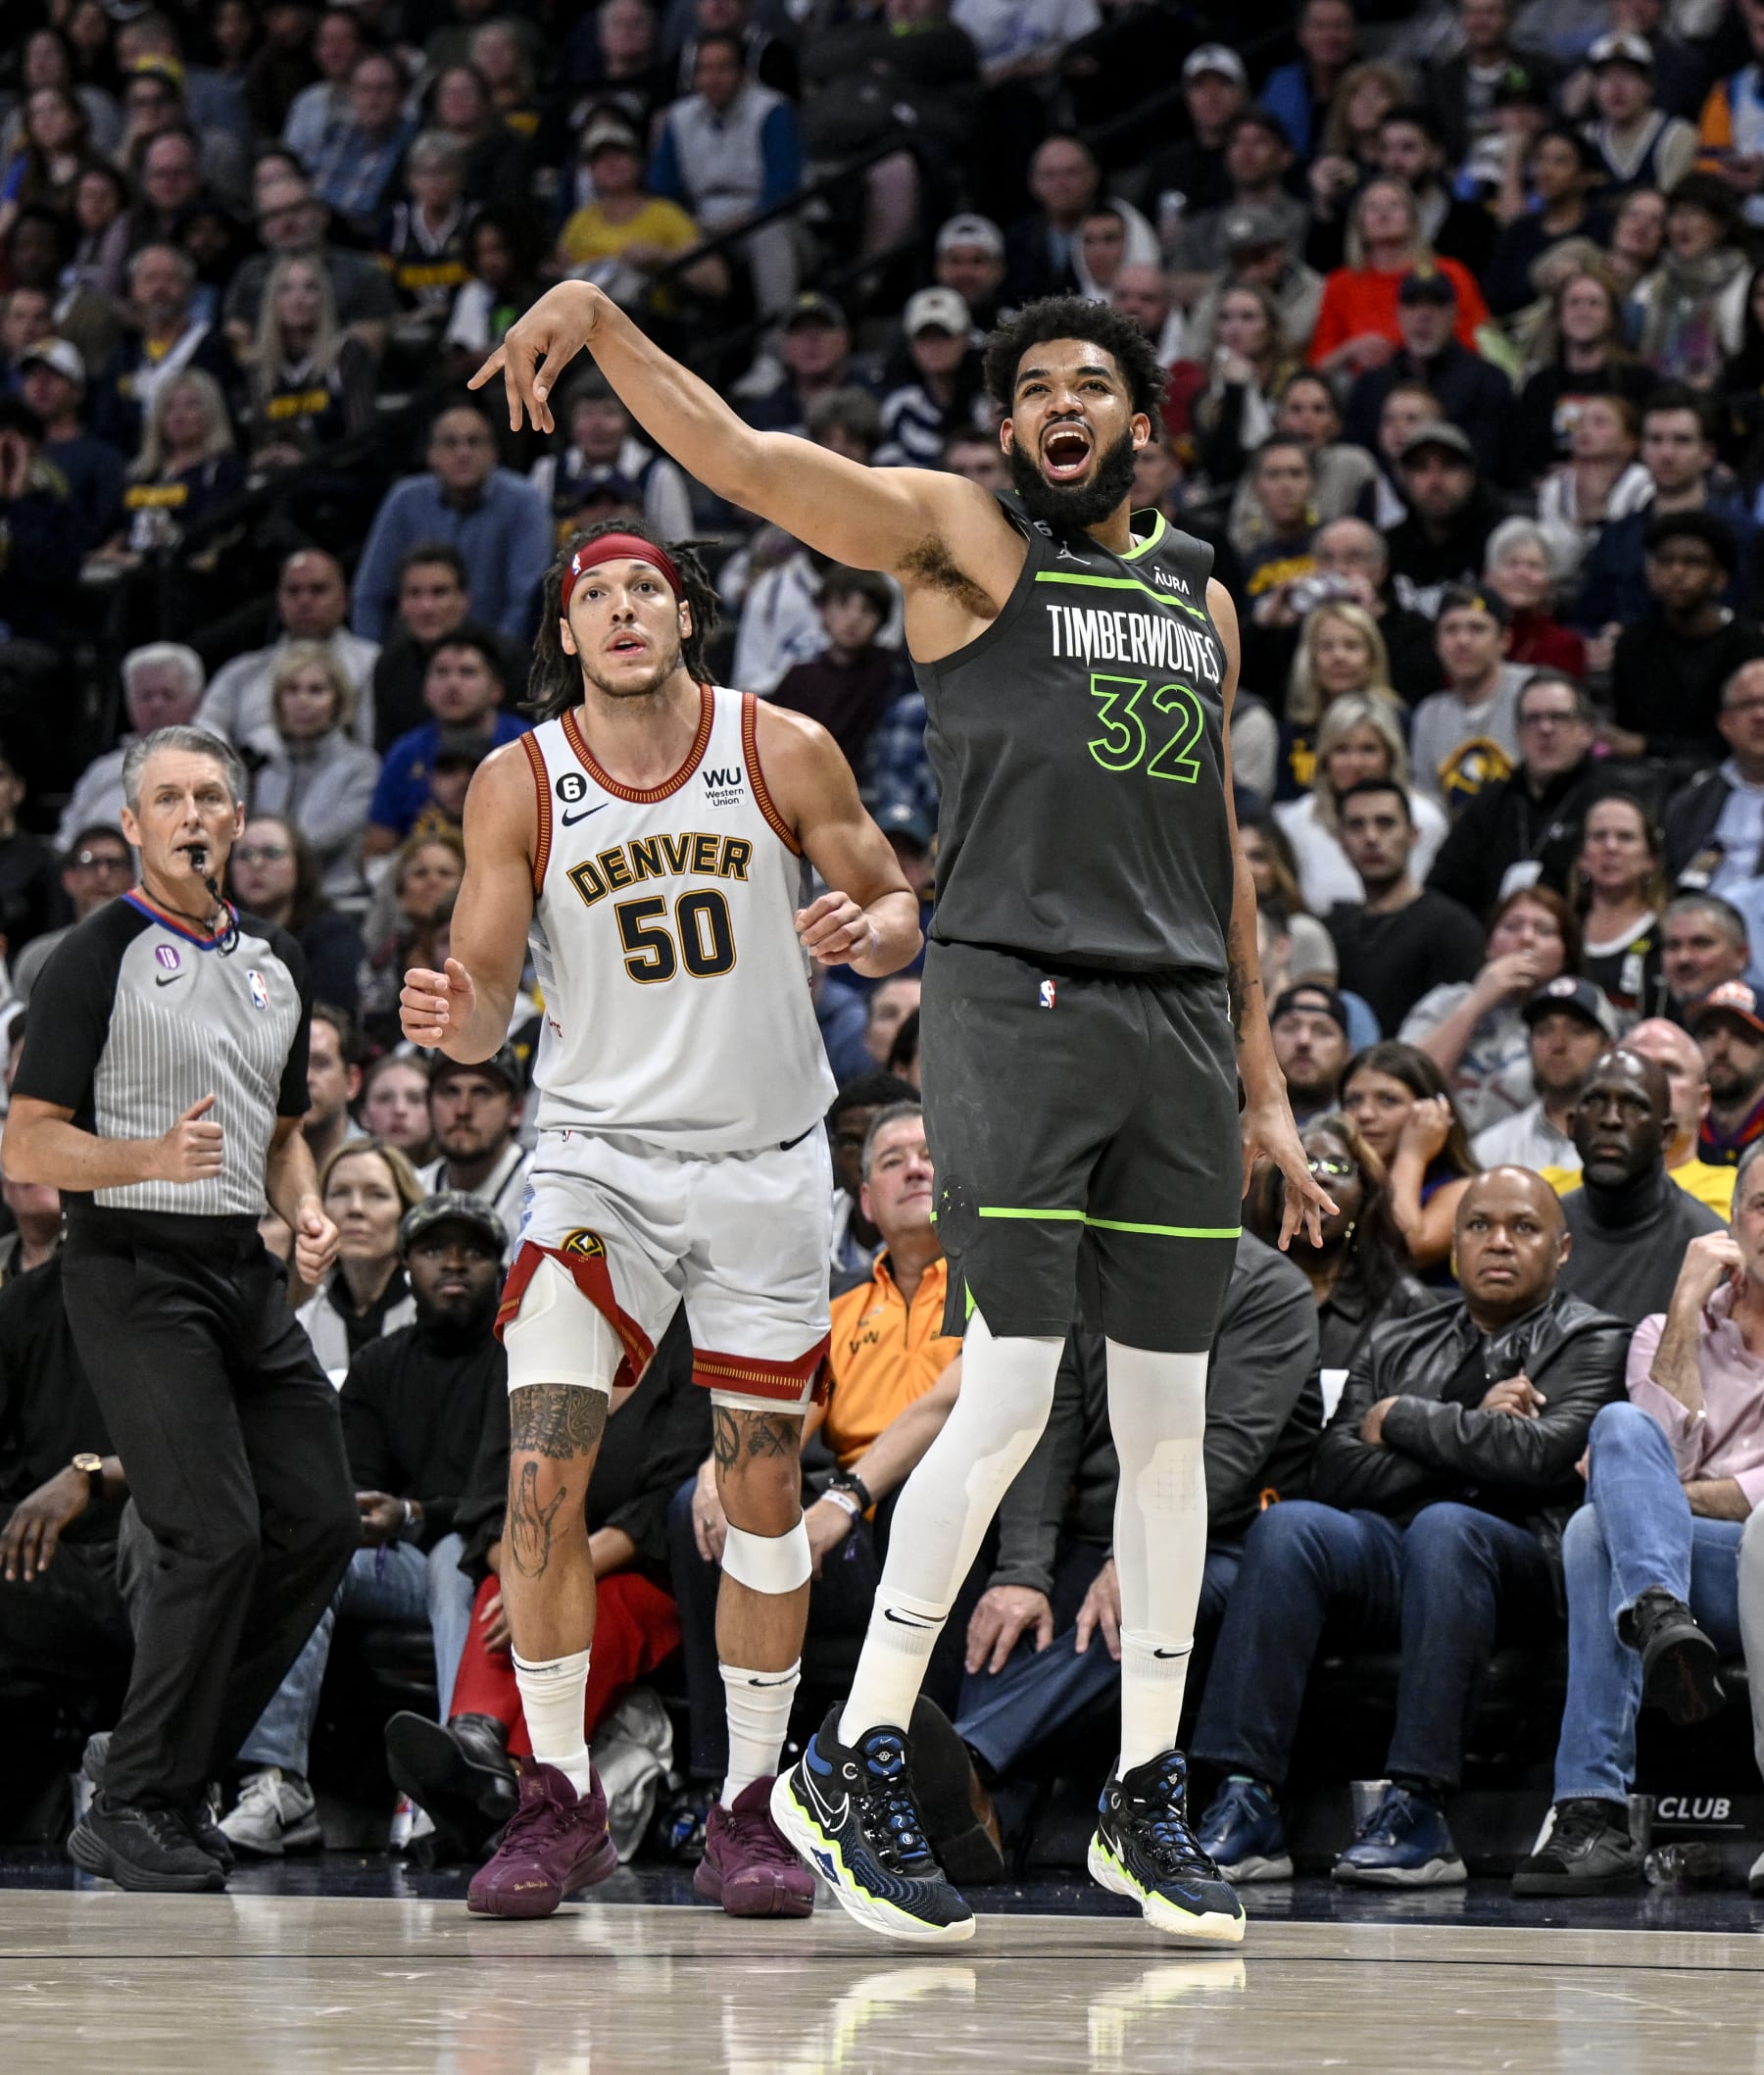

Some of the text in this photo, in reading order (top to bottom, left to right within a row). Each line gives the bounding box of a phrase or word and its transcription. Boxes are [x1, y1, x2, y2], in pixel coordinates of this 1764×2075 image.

[1047, 605, 1219, 684] TIMBERWOLVES
[1088, 673, 1203, 783] 32
[563, 776, 581, 800] 6
[703, 766, 742, 788] WU
[705, 787, 744, 800] Western
[712, 797, 740, 808] Union
[565, 832, 753, 908] DENVER
[613, 888, 737, 984] 50
[1657, 1797, 1731, 1819] CLUB
